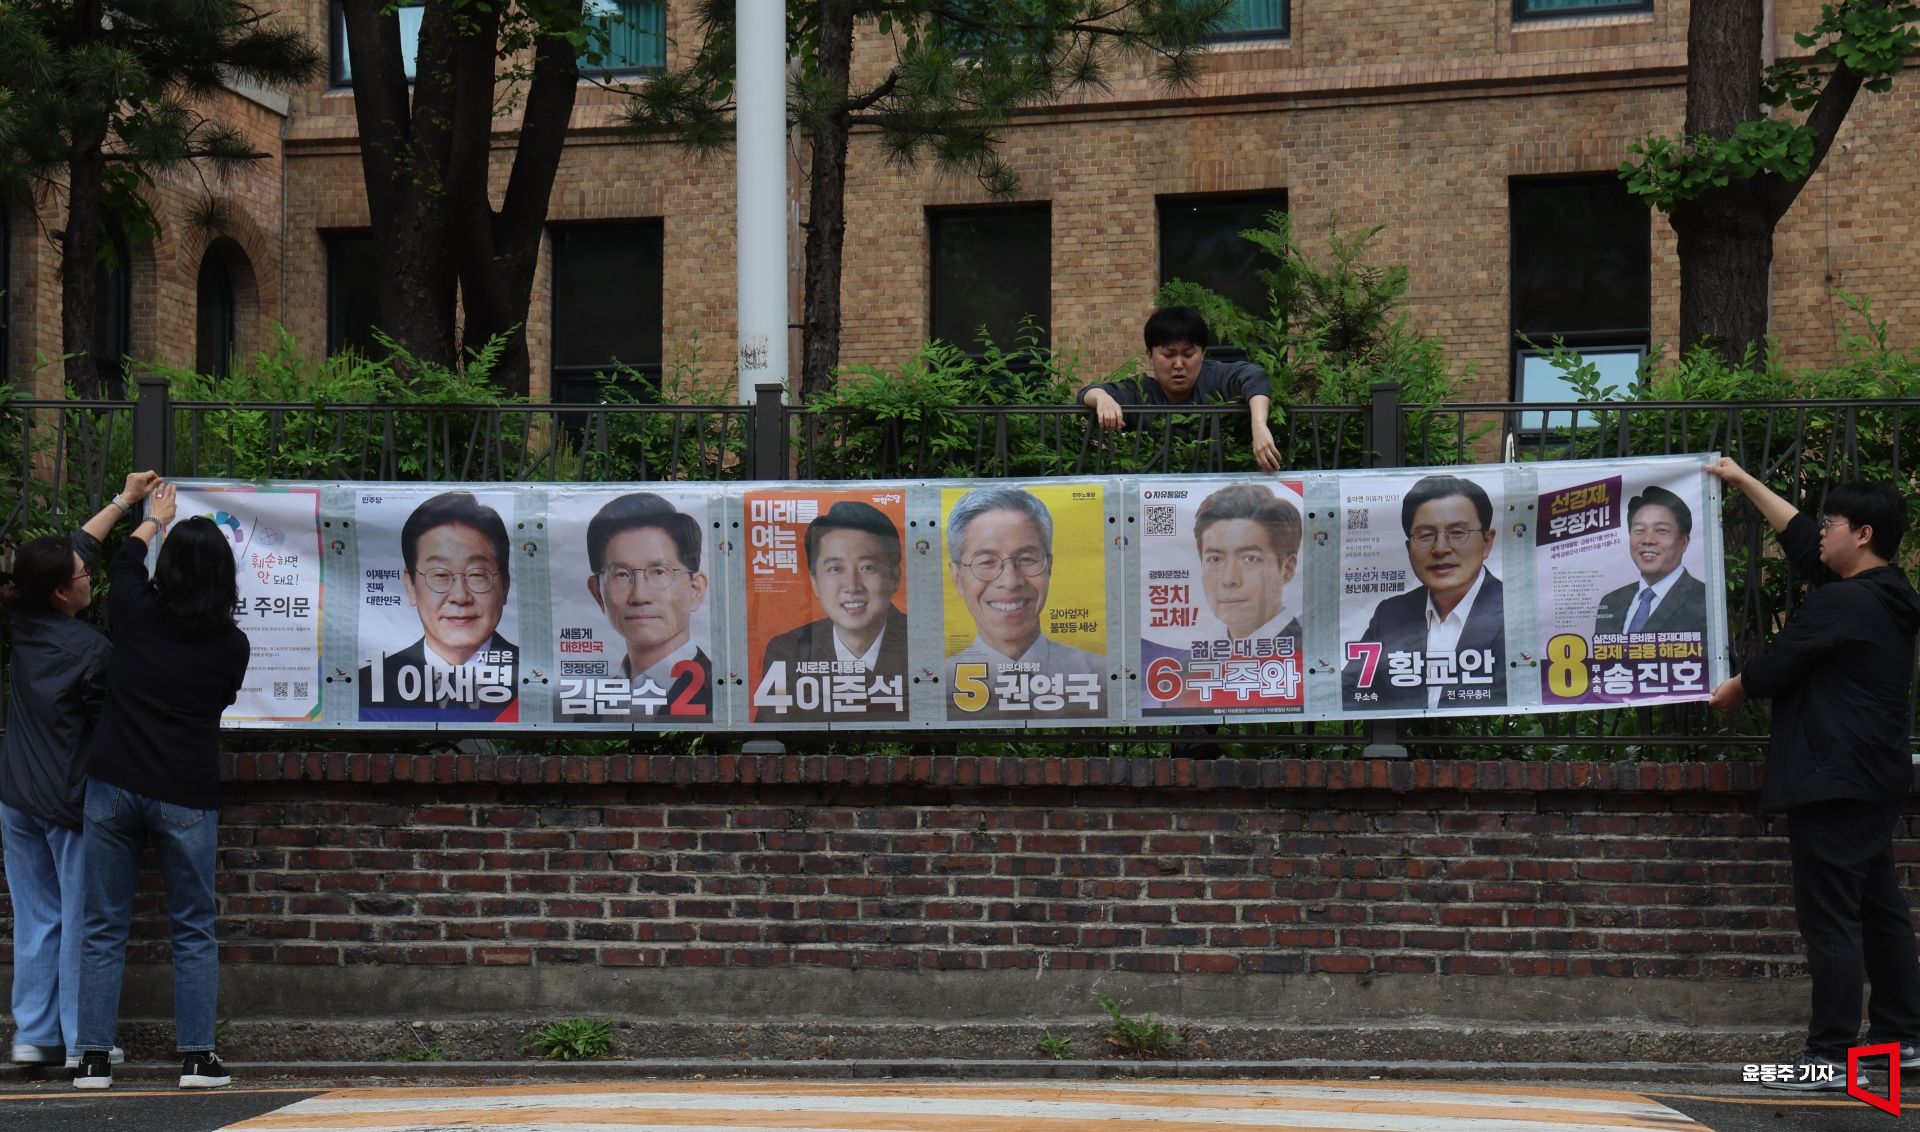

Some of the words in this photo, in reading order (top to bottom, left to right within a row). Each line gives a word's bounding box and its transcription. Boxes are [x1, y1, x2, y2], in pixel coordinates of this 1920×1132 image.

[362, 496, 382, 504] 민주당
[1153, 491, 1188, 499] 자유통일당
[1552, 484, 1609, 515] 선경제,
[751, 500, 819, 524] 미래를
[1550, 505, 1610, 538] 후정치!
[752, 525, 796, 549] 여는
[252, 552, 298, 569] 훼손하면
[752, 550, 798, 575] 선택
[257, 570, 269, 584] 안
[273, 575, 299, 586] 돼요!
[366, 570, 400, 580] 이제부터
[1149, 570, 1189, 579] 광화문정신
[1345, 571, 1378, 582] 부정선거
[1381, 570, 1406, 580] 척결로
[366, 582, 384, 593] 진짜
[1149, 584, 1190, 605] 정치
[1345, 583, 1378, 594] 청년에게
[1380, 582, 1405, 592] 미래를
[254, 597, 310, 618] 주의문
[366, 596, 401, 606] 대한민국
[1050, 609, 1089, 619] 갈아엎자!
[1150, 608, 1199, 628] 교체!
[560, 628, 592, 640] 새롭게
[1050, 623, 1078, 634] 불평등
[1079, 622, 1098, 633] 세상
[1593, 634, 1628, 644] 실천하는
[1630, 632, 1656, 642] 준비된
[1657, 632, 1701, 642] 경제대통령
[560, 641, 604, 653] 대한민국
[1658, 643, 1702, 658] 해결사
[477, 651, 513, 663] 지금은
[563, 662, 606, 674] 정정당당
[796, 661, 830, 673] 새로운
[831, 661, 866, 673] 대통령
[1346, 642, 1382, 688] 7
[1388, 649, 1495, 686] 황교안
[1547, 634, 1588, 697] 8
[366, 651, 385, 702] 1
[398, 664, 512, 703] 이재명
[1146, 657, 1184, 701] 6
[1186, 659, 1300, 701] 구주와
[1592, 664, 1602, 694] 무소속
[1604, 661, 1703, 694] 송진호
[559, 678, 668, 715] 김문수
[670, 660, 706, 716] 2
[754, 661, 793, 713] 4
[796, 675, 903, 712] 이준석
[953, 663, 990, 712] 5
[994, 673, 1101, 711] 권영국
[1447, 690, 1456, 699] 전
[1457, 689, 1491, 699] 국무총리
[1354, 692, 1378, 701] 무소속
